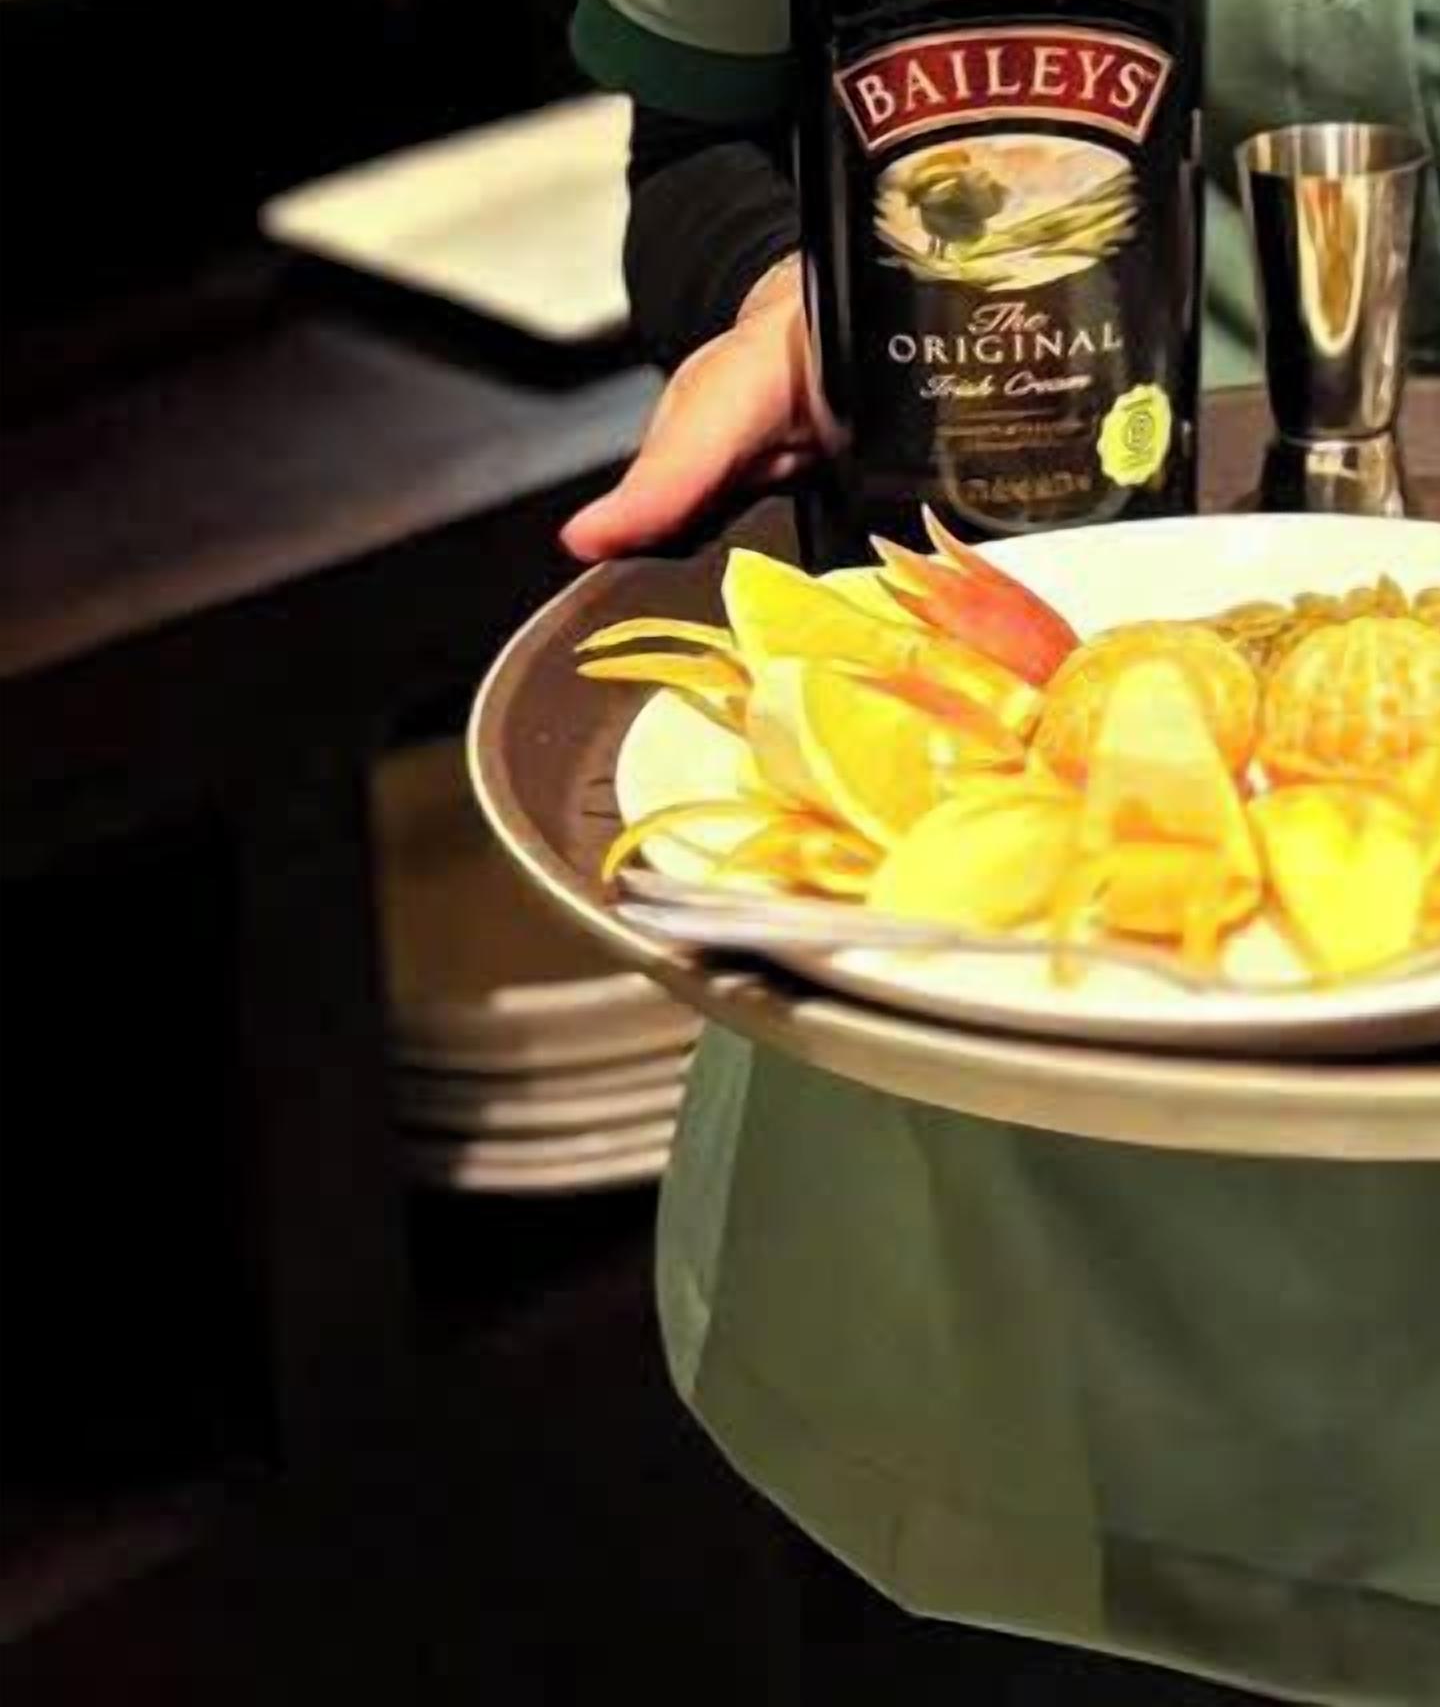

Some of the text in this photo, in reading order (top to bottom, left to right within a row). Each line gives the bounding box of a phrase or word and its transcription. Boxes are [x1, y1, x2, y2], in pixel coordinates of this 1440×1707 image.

[857, 47, 1152, 125] BAILEYS
[967, 301, 1051, 334] The
[887, 321, 1122, 363] ORIGINAL
